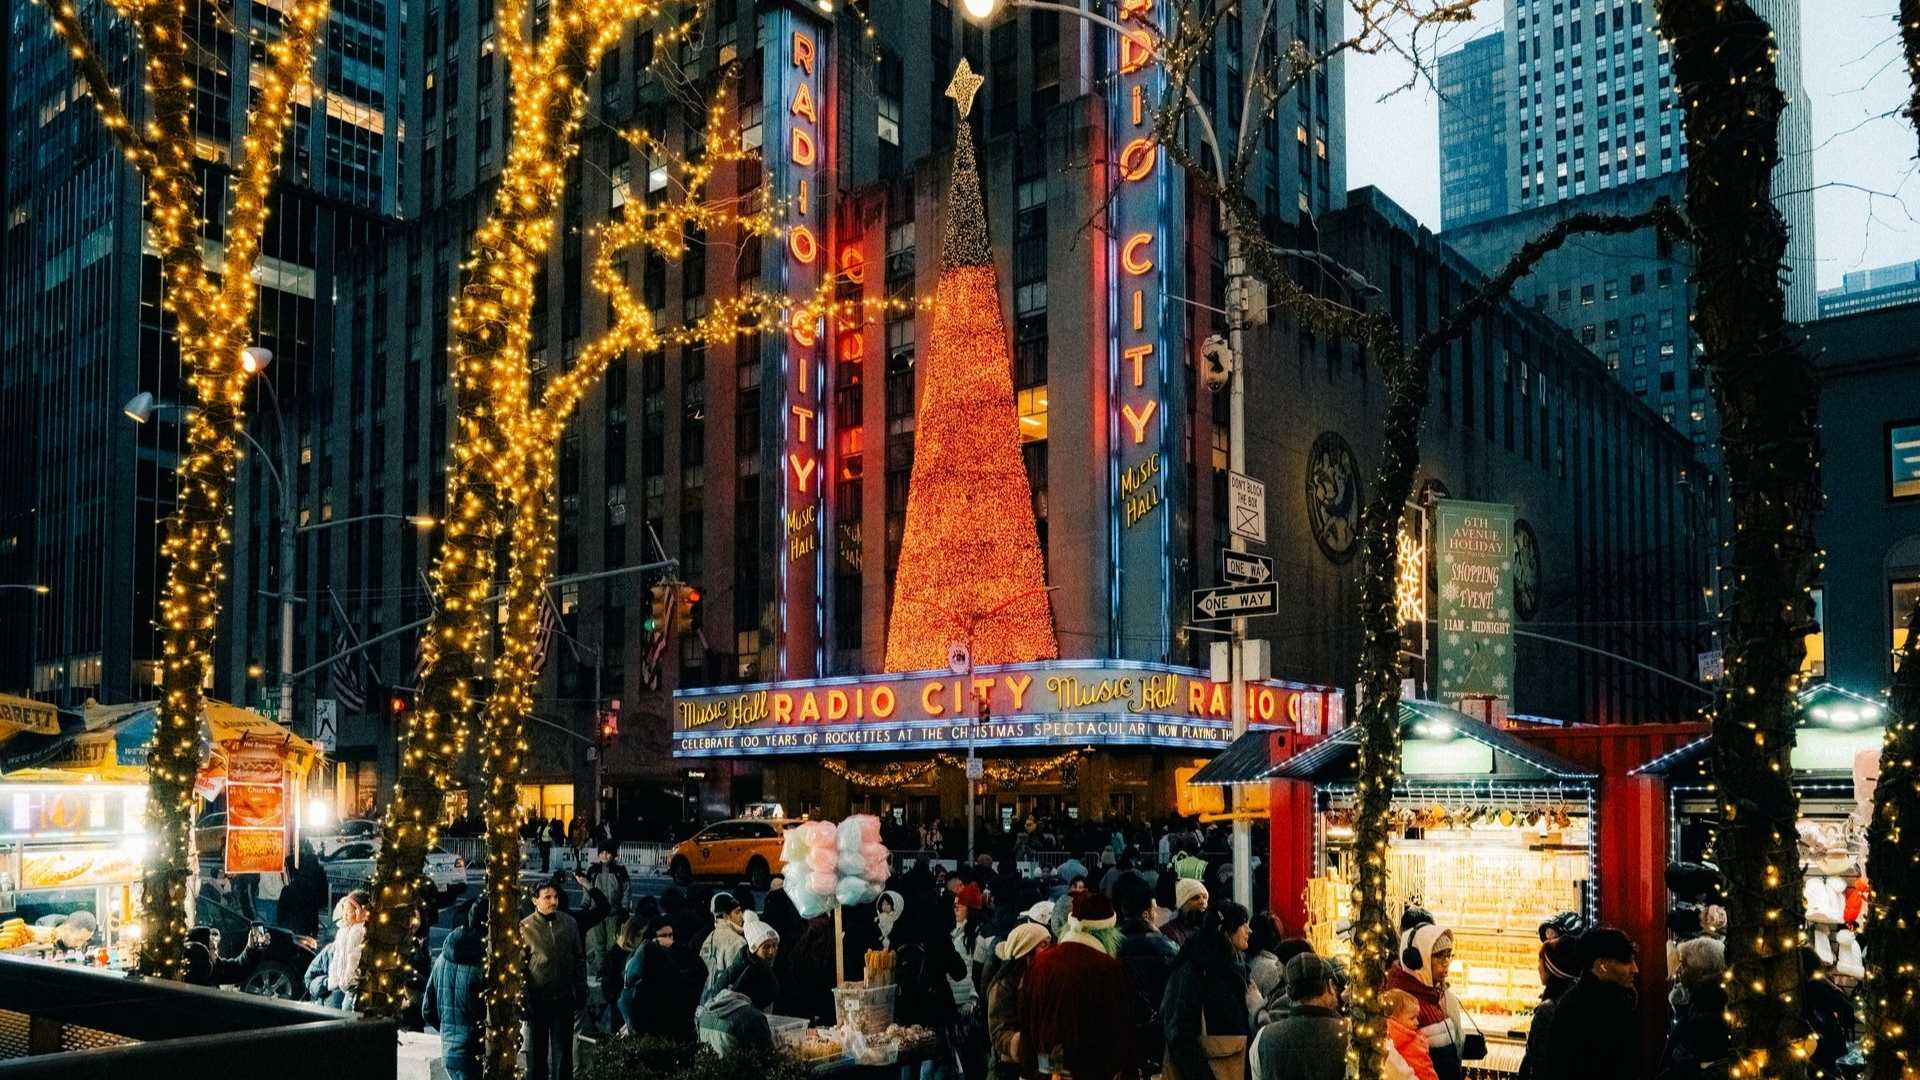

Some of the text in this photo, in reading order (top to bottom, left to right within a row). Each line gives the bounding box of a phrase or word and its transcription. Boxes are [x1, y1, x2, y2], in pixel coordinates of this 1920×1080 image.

[790, 31, 817, 263] RADIO
[1122, 232, 1157, 444] CITY
[789, 310, 816, 492] CITY
[1121, 453, 1159, 500] MUSIC
[1232, 477, 1263, 497] DON'T BLOCK
[1127, 487, 1158, 528] HALL
[1237, 492, 1258, 508] THE BOX
[787, 504, 815, 532] MUSIC
[1464, 517, 1488, 528] 6TH
[1450, 538, 1504, 553] HOLIDAY
[1453, 528, 1500, 541] AVENUE
[790, 535, 814, 562] HALL
[1230, 560, 1265, 578] ONE WAY
[1451, 561, 1499, 588] SHOPPING
[1205, 593, 1266, 610] ONE WAY
[1460, 588, 1494, 609] EVENT!
[1444, 619, 1465, 632] 11AM
[1471, 620, 1510, 635] MIDNIGHT
[680, 701, 727, 729] Music
[724, 690, 769, 729] Hall
[774, 686, 895, 724] RADIO
[921, 674, 1033, 715] CITY
[1046, 675, 1133, 712] Music
[1128, 673, 1178, 713] Hall
[1187, 681, 1275, 720] RAIO
[681, 736, 735, 750] CELEBRATE
[741, 736, 759, 748] 100
[766, 733, 798, 747] YEARS
[804, 732, 818, 745] OF
[825, 729, 891, 744] ROCKETTES
[898, 729, 913, 741] AT
[922, 728, 943, 740] THE
[1158, 723, 1178, 737] NOW
[1182, 726, 1217, 740] PLAYING
